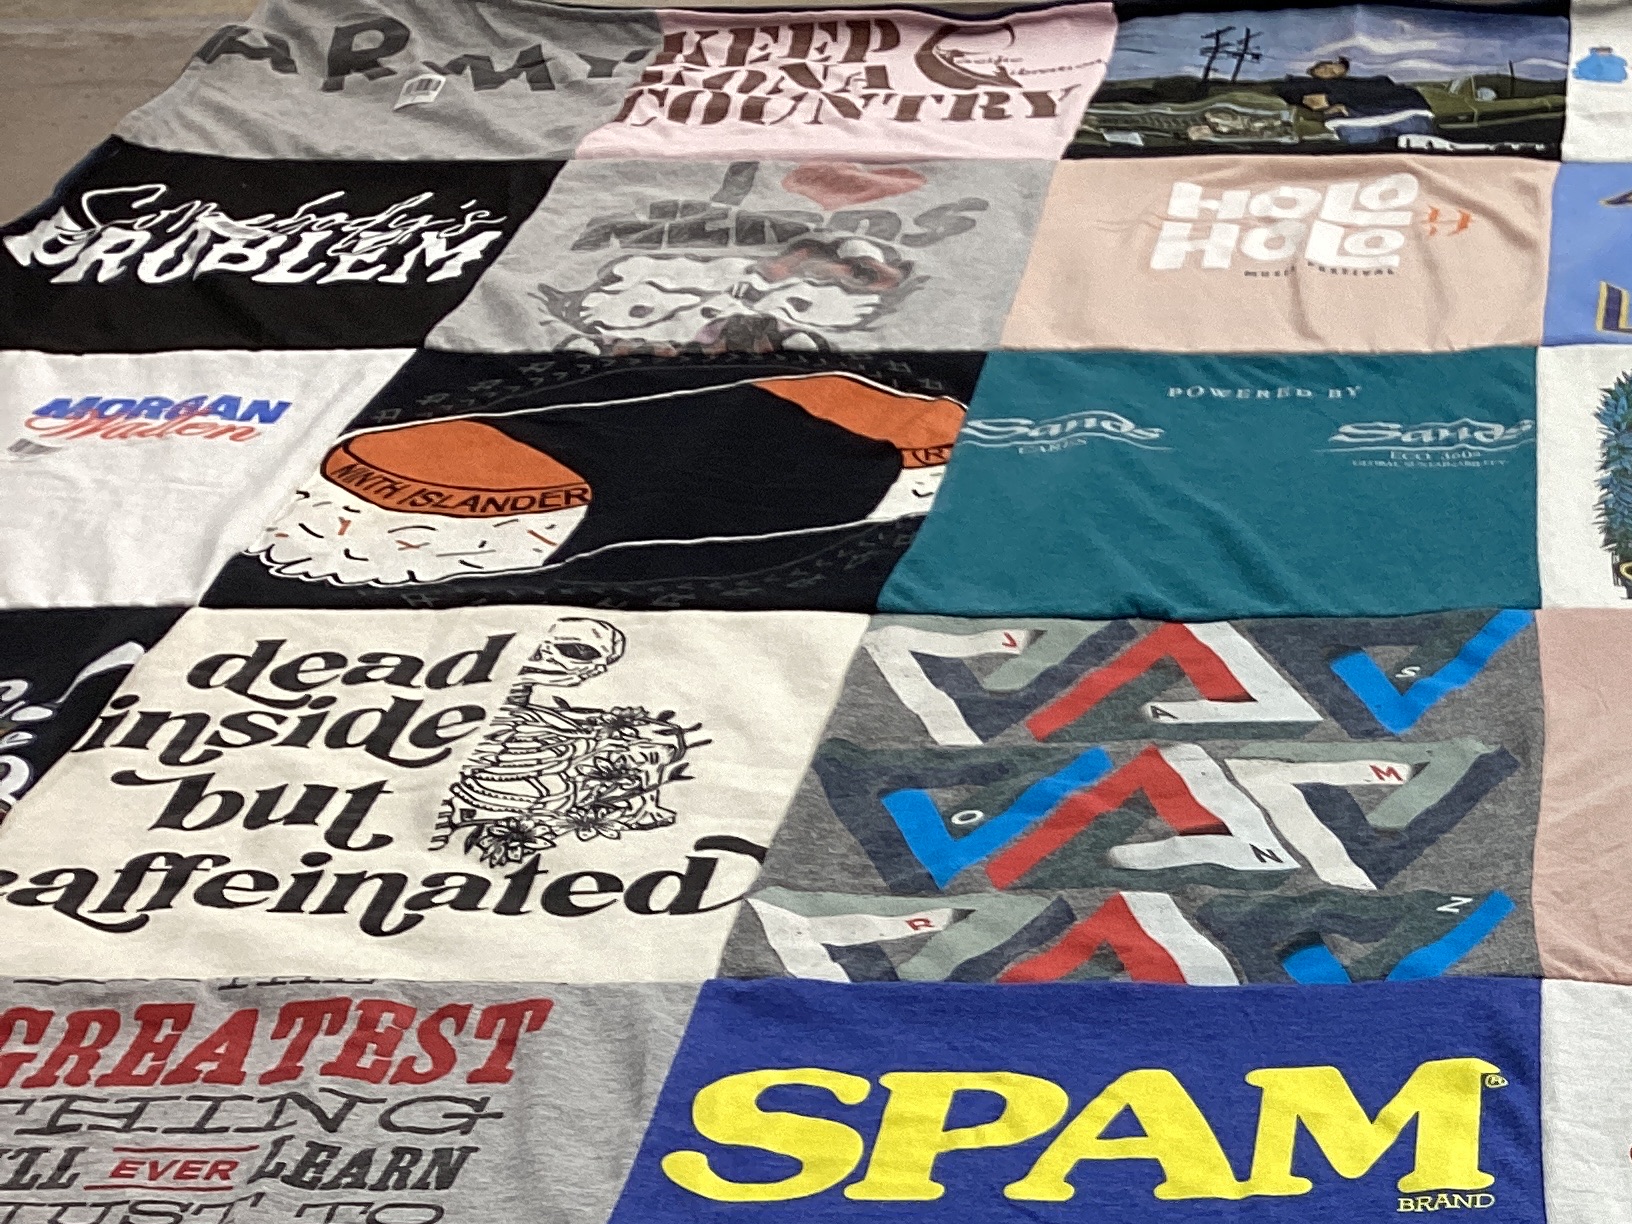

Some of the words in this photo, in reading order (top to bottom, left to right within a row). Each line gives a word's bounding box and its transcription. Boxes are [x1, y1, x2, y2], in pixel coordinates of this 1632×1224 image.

[198, 17, 653, 92] ARMY
[654, 18, 900, 67] KEEP
[612, 85, 1078, 126] COUNTRY
[1168, 172, 1419, 226] HOLO
[1150, 219, 1405, 269] HOLO
[32, 394, 293, 424] MORGAN
[1167, 385, 1313, 399] POWERED
[1328, 385, 1362, 398] BY
[331, 461, 406, 498] NINTH
[408, 485, 591, 515] ISLANDER
[187, 631, 516, 709] dead
[71, 693, 487, 768] inside
[111, 769, 394, 851] but
[0, 835, 768, 938] affeinated
[0, 997, 554, 1090] GREATEST
[660, 1057, 1501, 1203] SPAM
[109, 1159, 238, 1182] EVER
[247, 1134, 481, 1191] LEARN
[1396, 1193, 1496, 1213] BRAND
